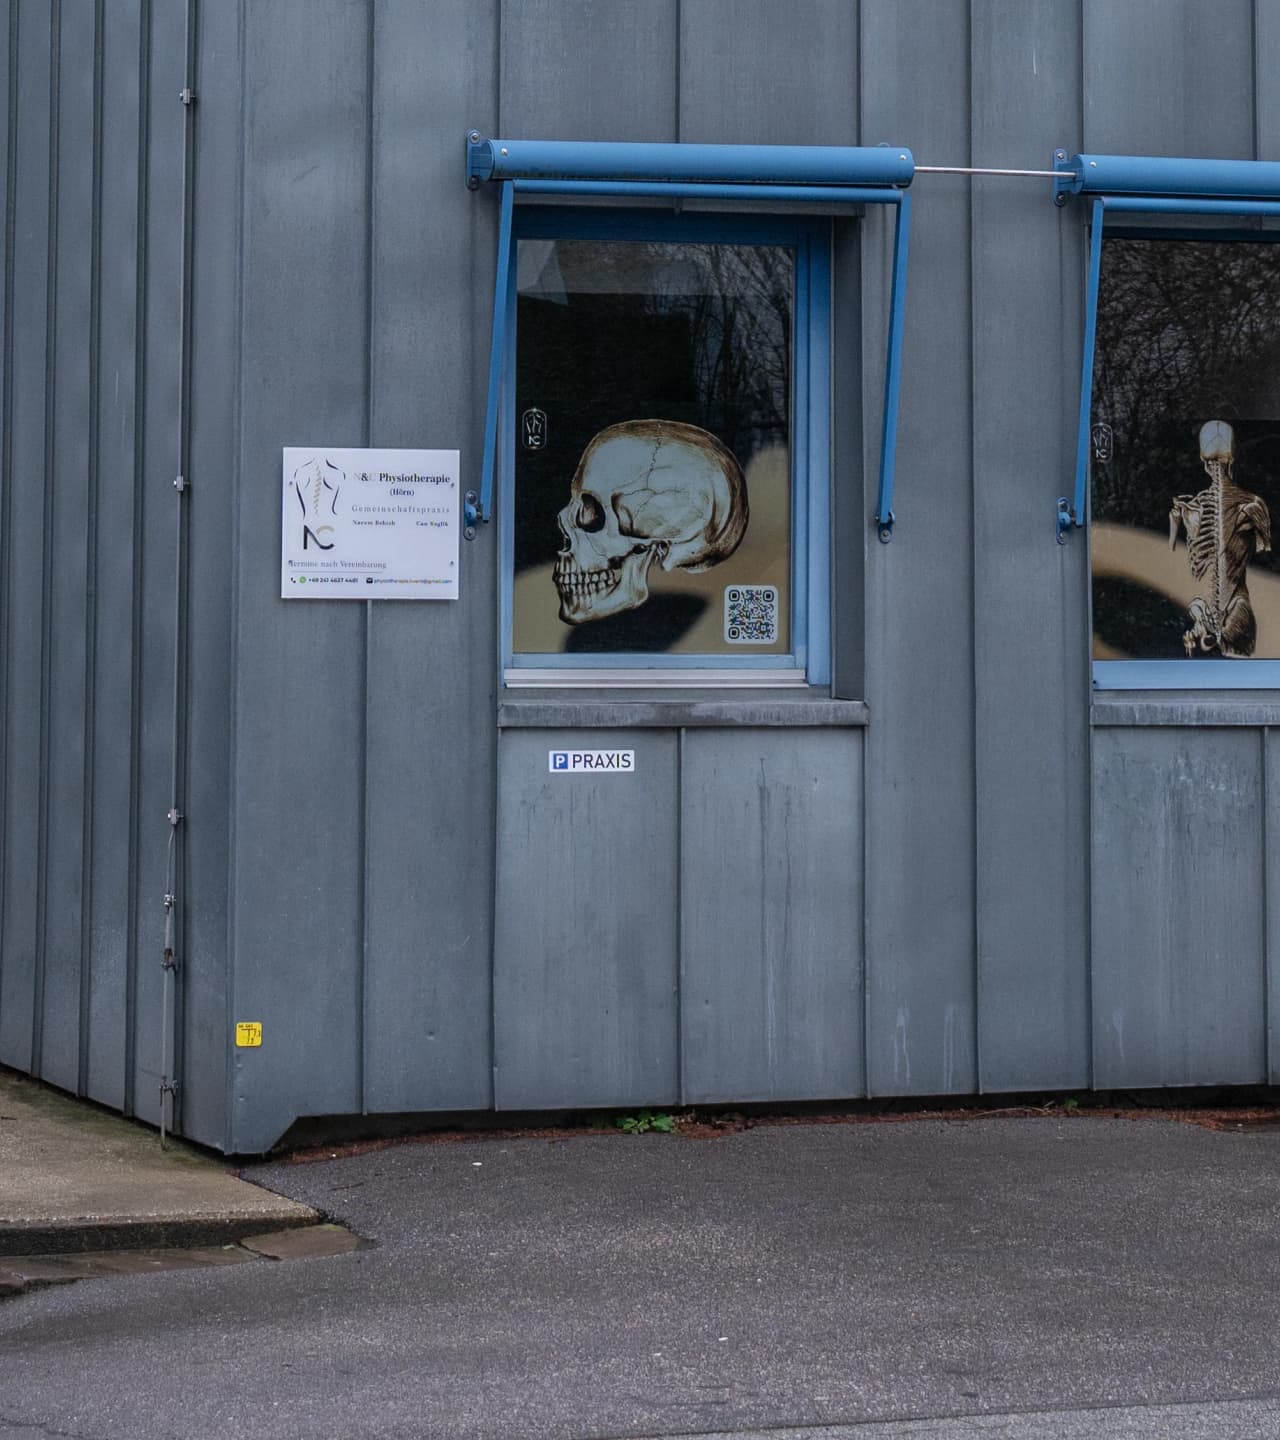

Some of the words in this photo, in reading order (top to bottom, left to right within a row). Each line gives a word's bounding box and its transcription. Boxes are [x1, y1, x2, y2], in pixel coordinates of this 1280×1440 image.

[379, 472, 451, 485] Physiotherapie
[389, 488, 415, 497] (Hörn)
[351, 504, 451, 516] Gemeinschaftspraxis
[288, 560, 319, 568] Termine
[340, 561, 387, 570] Vereinbarung
[572, 753, 631, 769] PRAXIS
